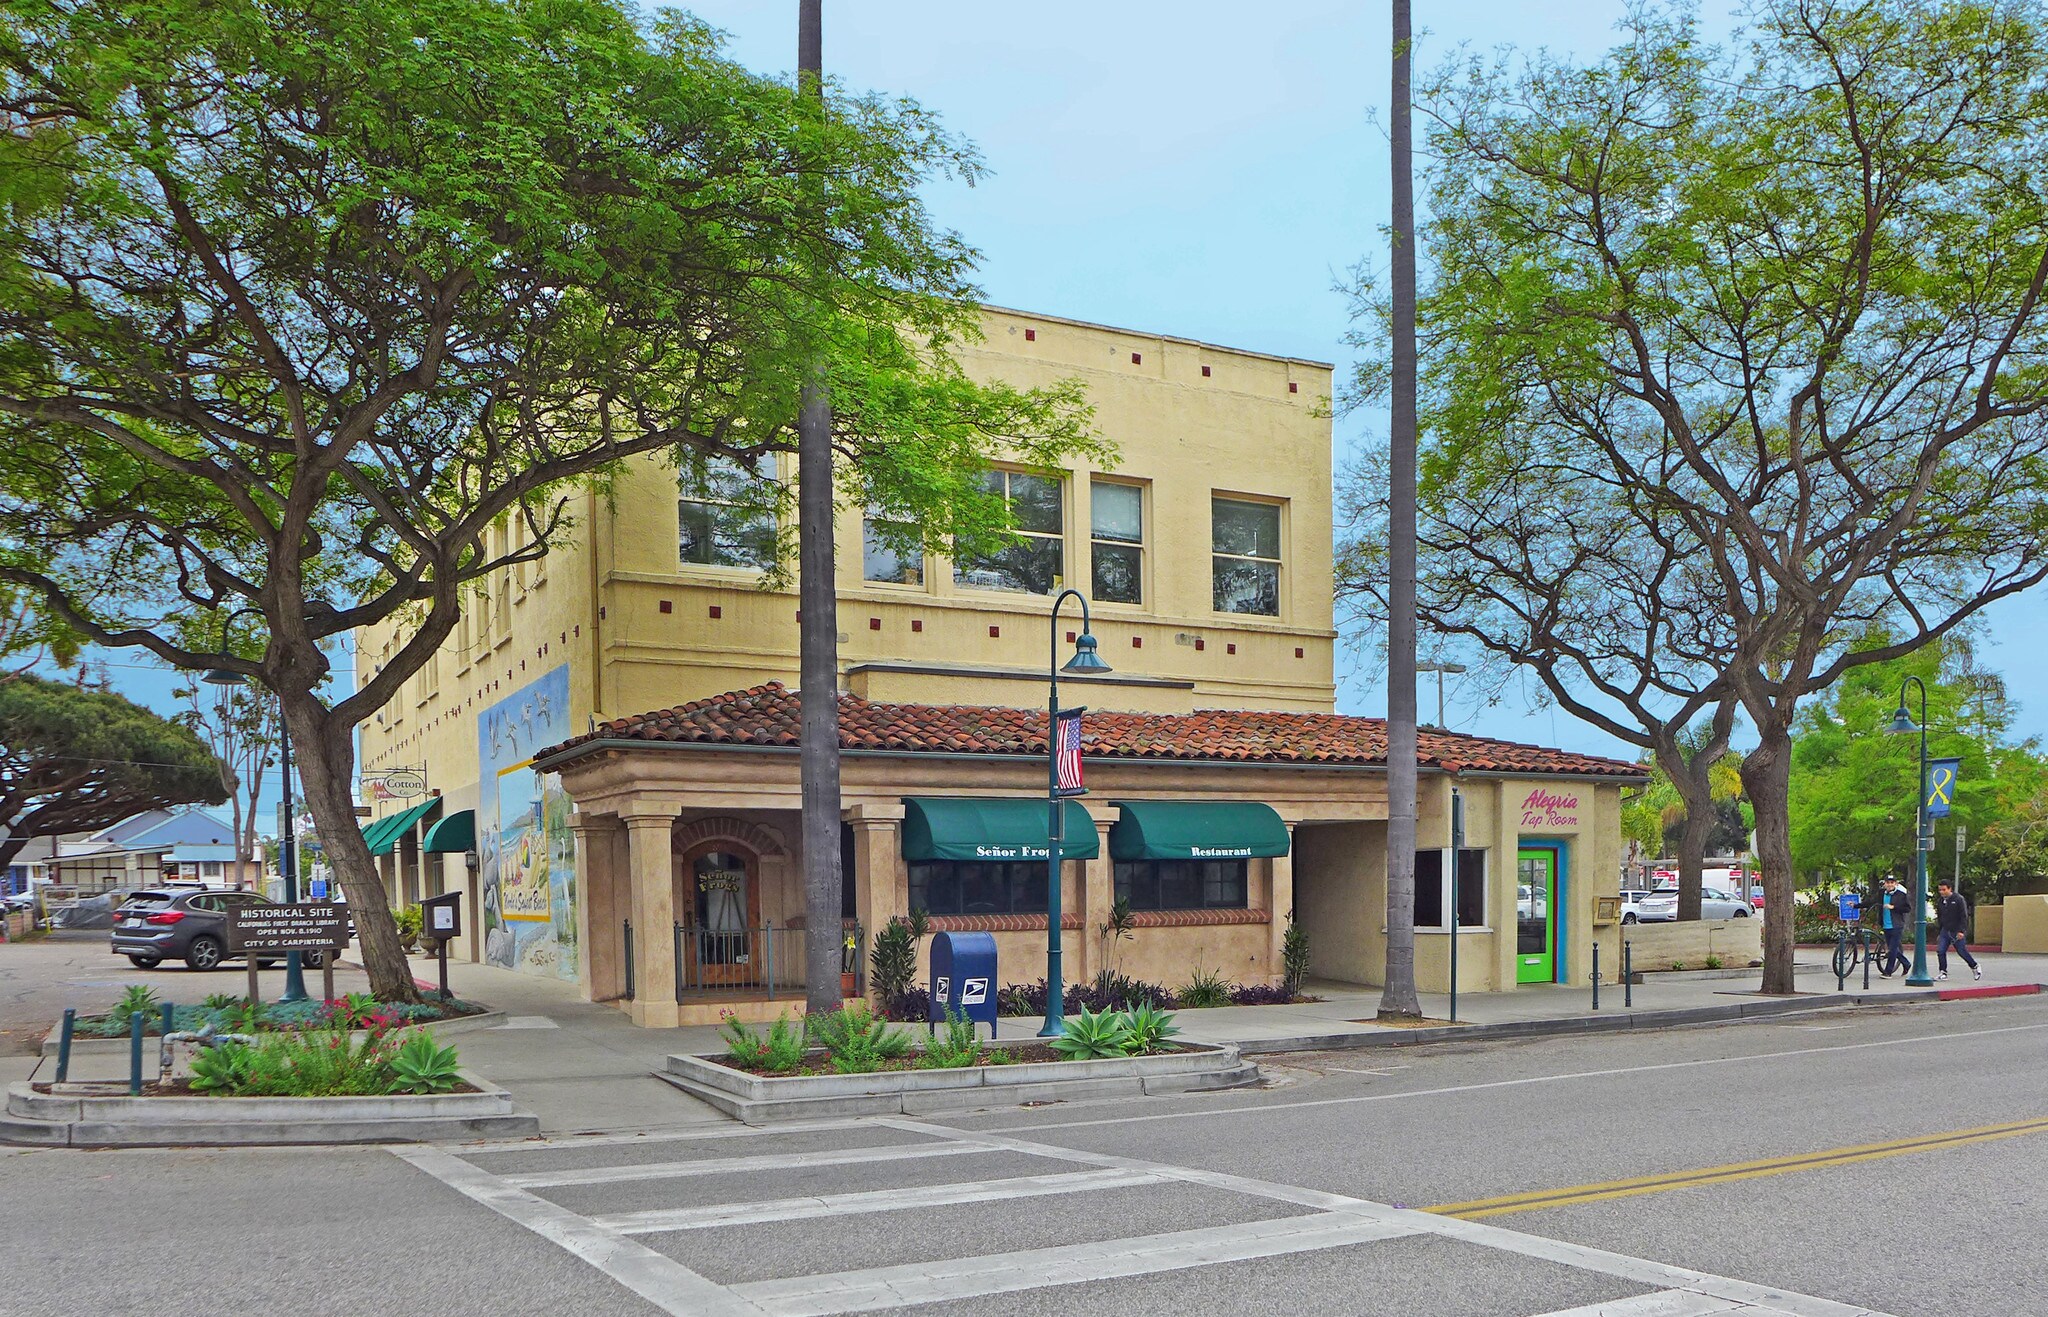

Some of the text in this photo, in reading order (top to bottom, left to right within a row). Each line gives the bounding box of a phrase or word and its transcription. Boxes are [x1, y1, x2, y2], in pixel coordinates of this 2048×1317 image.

[387, 779, 421, 788] Cotton
[1521, 789, 1578, 815] Alegria
[1521, 810, 1577, 829] Tap Room
[976, 845, 1016, 857] Señor
[1191, 847, 1252, 857] Restaurant
[699, 869, 740, 882] Señor
[699, 881, 740, 892] Frogs
[240, 908, 334, 918] HISTORICAL SITE
[282, 938, 334, 946] CARPINTERIA
